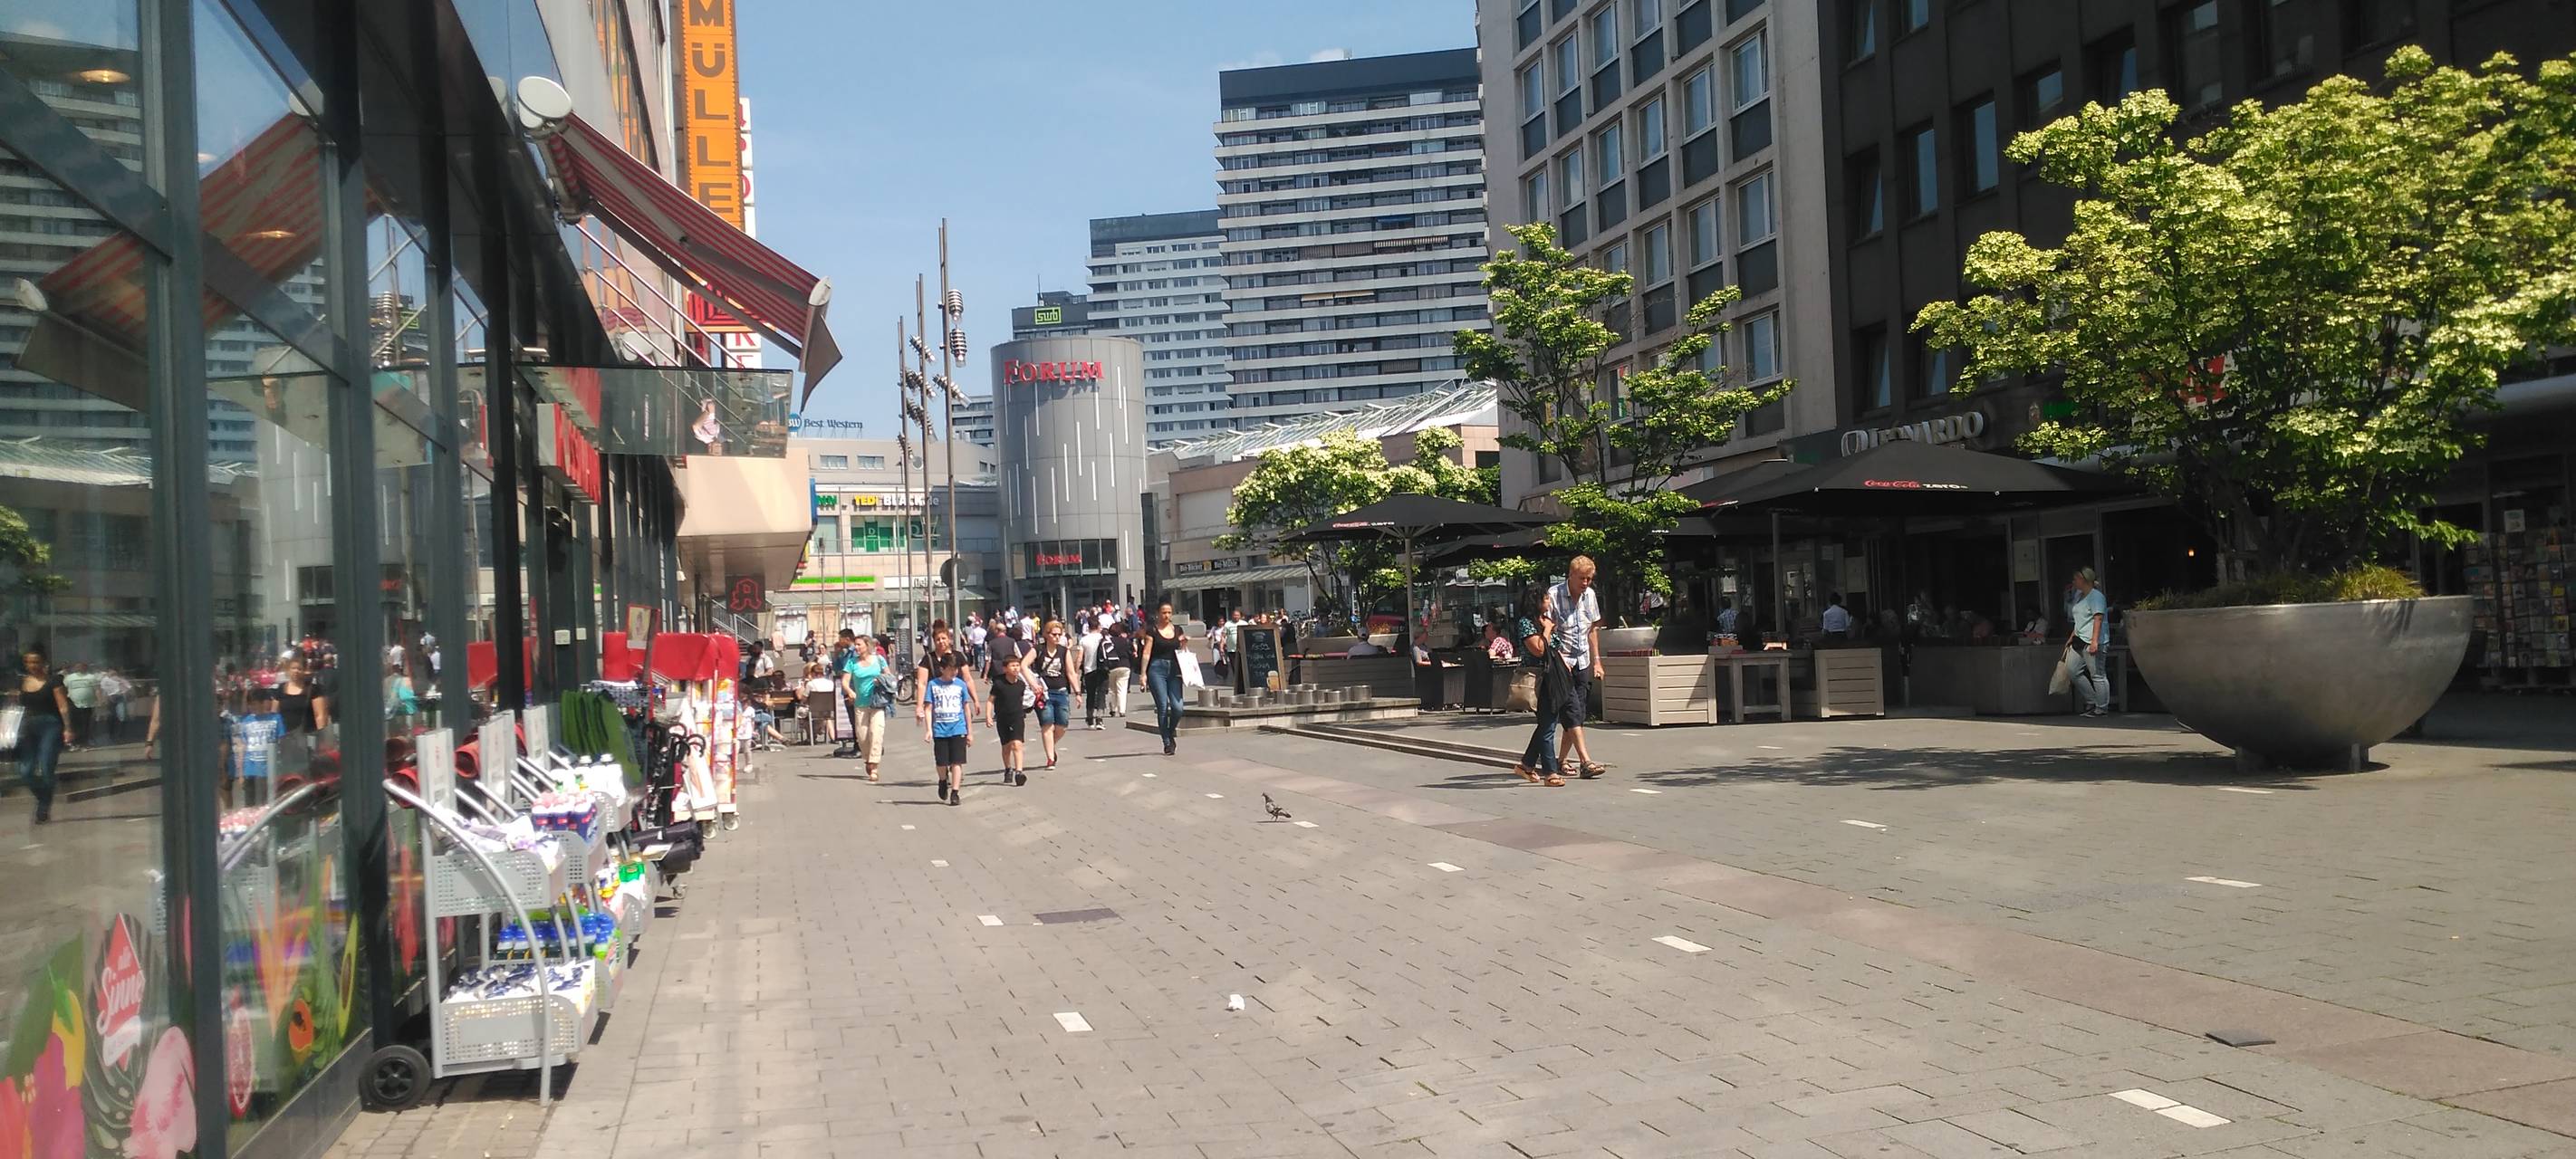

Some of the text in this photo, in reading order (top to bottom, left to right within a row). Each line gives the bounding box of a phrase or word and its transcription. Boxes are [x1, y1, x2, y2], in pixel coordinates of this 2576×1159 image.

[688, 0, 734, 214] MÜLLE
[1004, 359, 1105, 385] FORUM
[804, 418, 863, 429] Best Western
[96, 967, 146, 1035] Sinne
